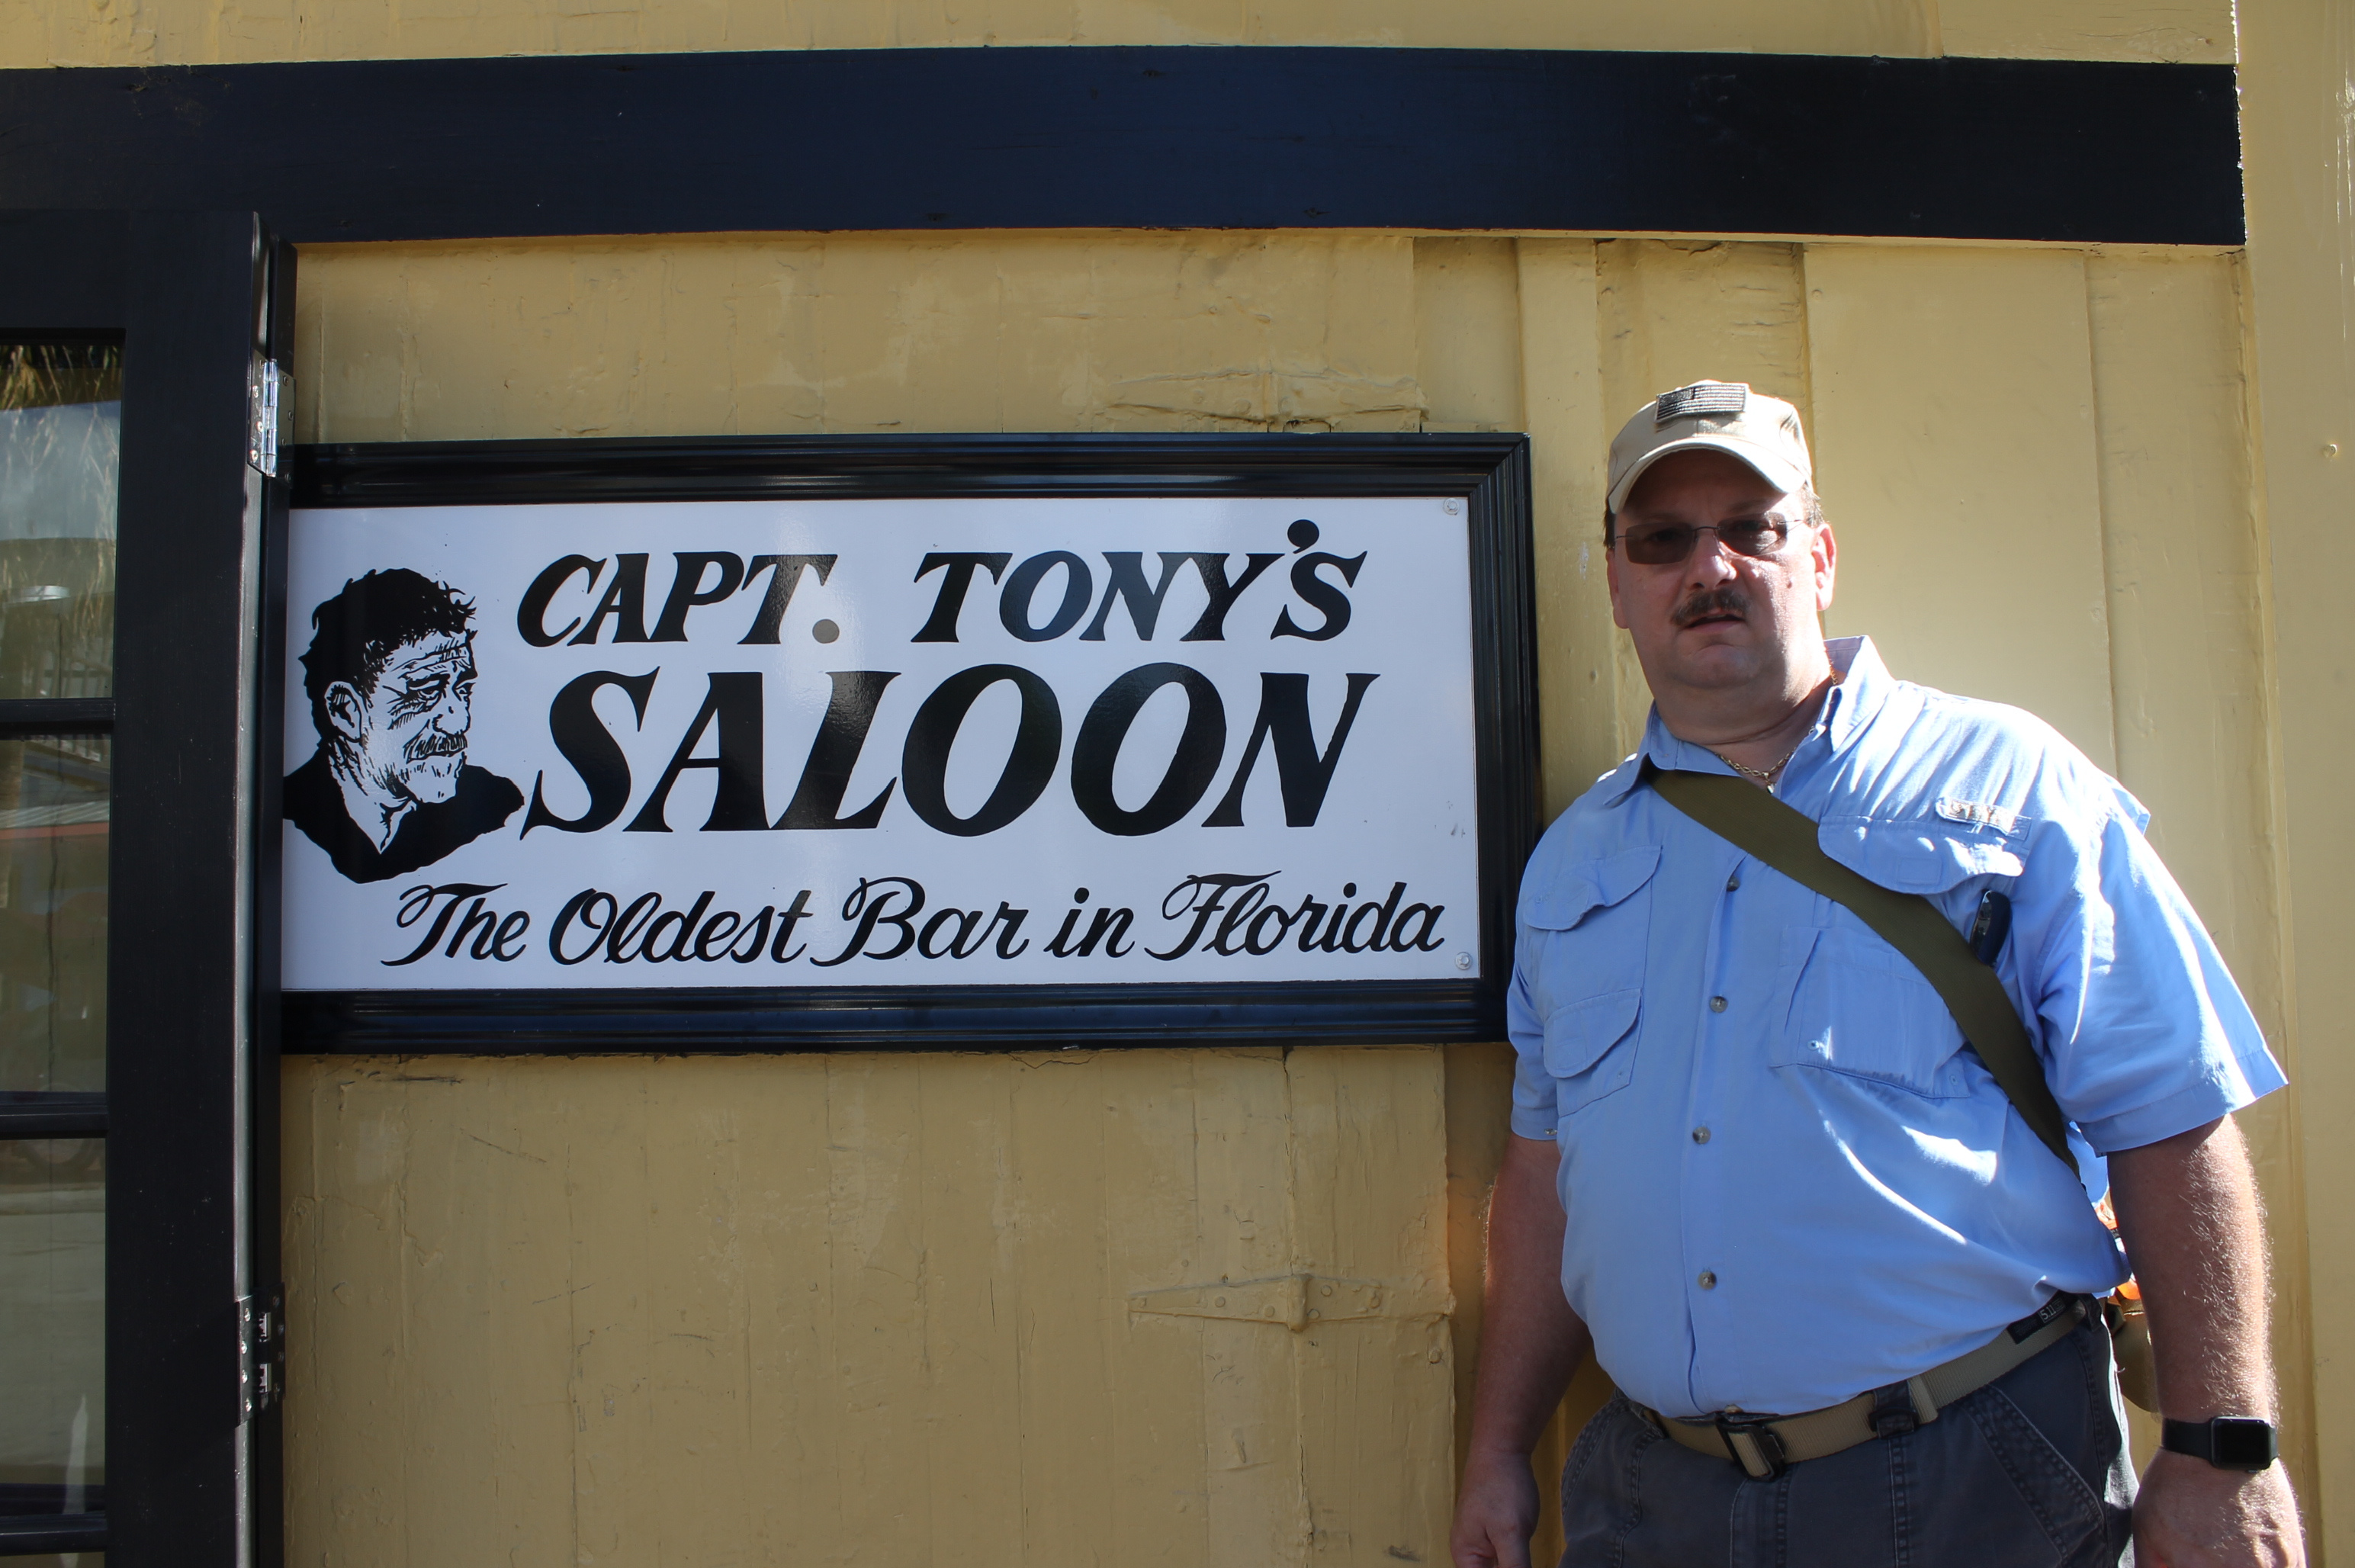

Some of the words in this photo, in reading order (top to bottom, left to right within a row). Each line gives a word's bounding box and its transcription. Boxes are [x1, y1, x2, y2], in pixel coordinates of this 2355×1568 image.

[517, 551, 839, 647] CAPT.
[910, 519, 1367, 642] TONY'S
[519, 664, 1380, 840] SALOON
[381, 882, 530, 966] The
[548, 888, 814, 966] Oldest
[810, 876, 1030, 967] Bar
[1043, 887, 1136, 959] in
[1144, 870, 1445, 961] Florida
